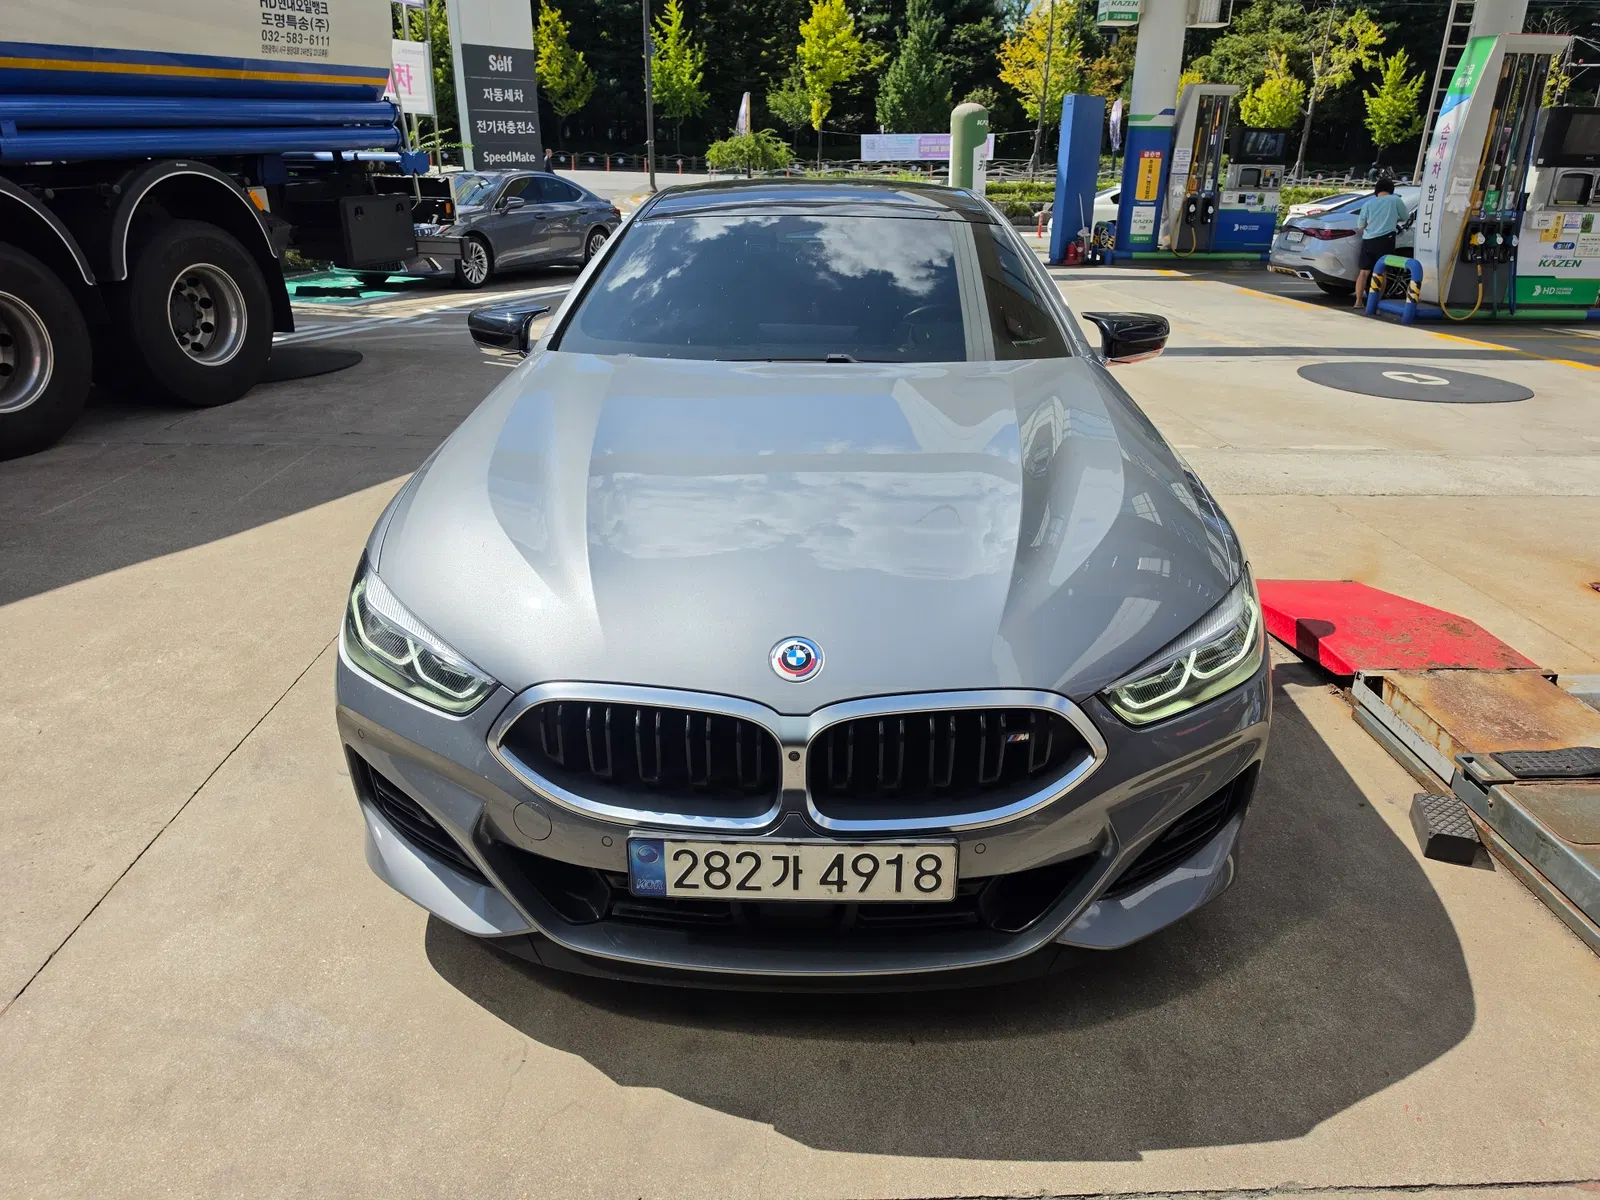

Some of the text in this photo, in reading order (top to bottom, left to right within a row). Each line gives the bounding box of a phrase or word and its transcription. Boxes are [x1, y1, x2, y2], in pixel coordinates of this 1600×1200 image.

[261, 12, 330, 32] 도명특송(주)
[261, 29, 330, 46] 032-583-6111
[488, 54, 513, 72] Self
[483, 87, 524, 103] 자동세차
[476, 120, 536, 135] 전기차충전소
[483, 151, 536, 165] SpeedMate
[1422, 183, 1438, 238] 합니다
[1538, 259, 1582, 268] KAZEN
[1542, 287, 1556, 295] HD
[672, 849, 943, 893] 282가 4918
